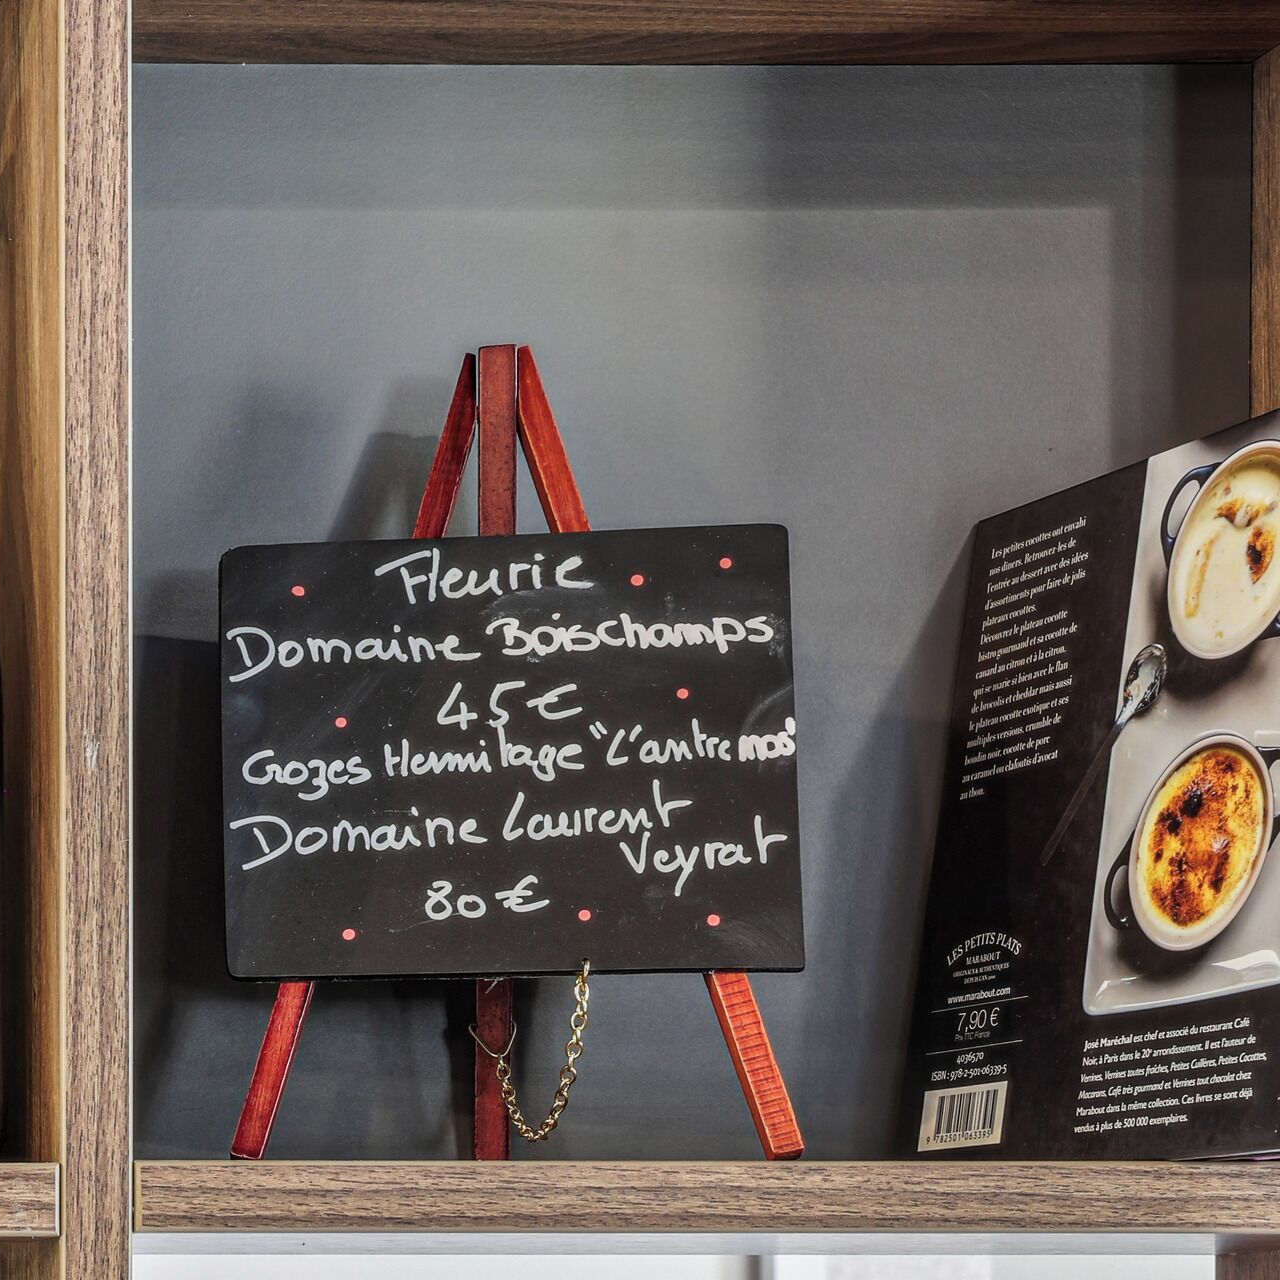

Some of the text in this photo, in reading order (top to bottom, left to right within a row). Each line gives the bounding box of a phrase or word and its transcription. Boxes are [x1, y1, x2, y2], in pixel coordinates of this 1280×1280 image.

[375, 548, 593, 604] Fleurie
[227, 613, 773, 682] Domaine Boischamps
[231, 779, 693, 870] Domaine Laurent
[620, 815, 787, 896] Veyrat
[947, 932, 1021, 966] LES PETITS PLATS
[966, 951, 1000, 965] MARABOUT
[948, 987, 1010, 1004] www.marabout.com
[958, 1007, 1000, 1032] 7,90 €
[1084, 1038, 1099, 1052] José
[1100, 1034, 1132, 1049] Maréchal
[1166, 1026, 1189, 1038] associé
[1199, 1020, 1233, 1033] restaurant
[957, 1052, 984, 1064] 4036570
